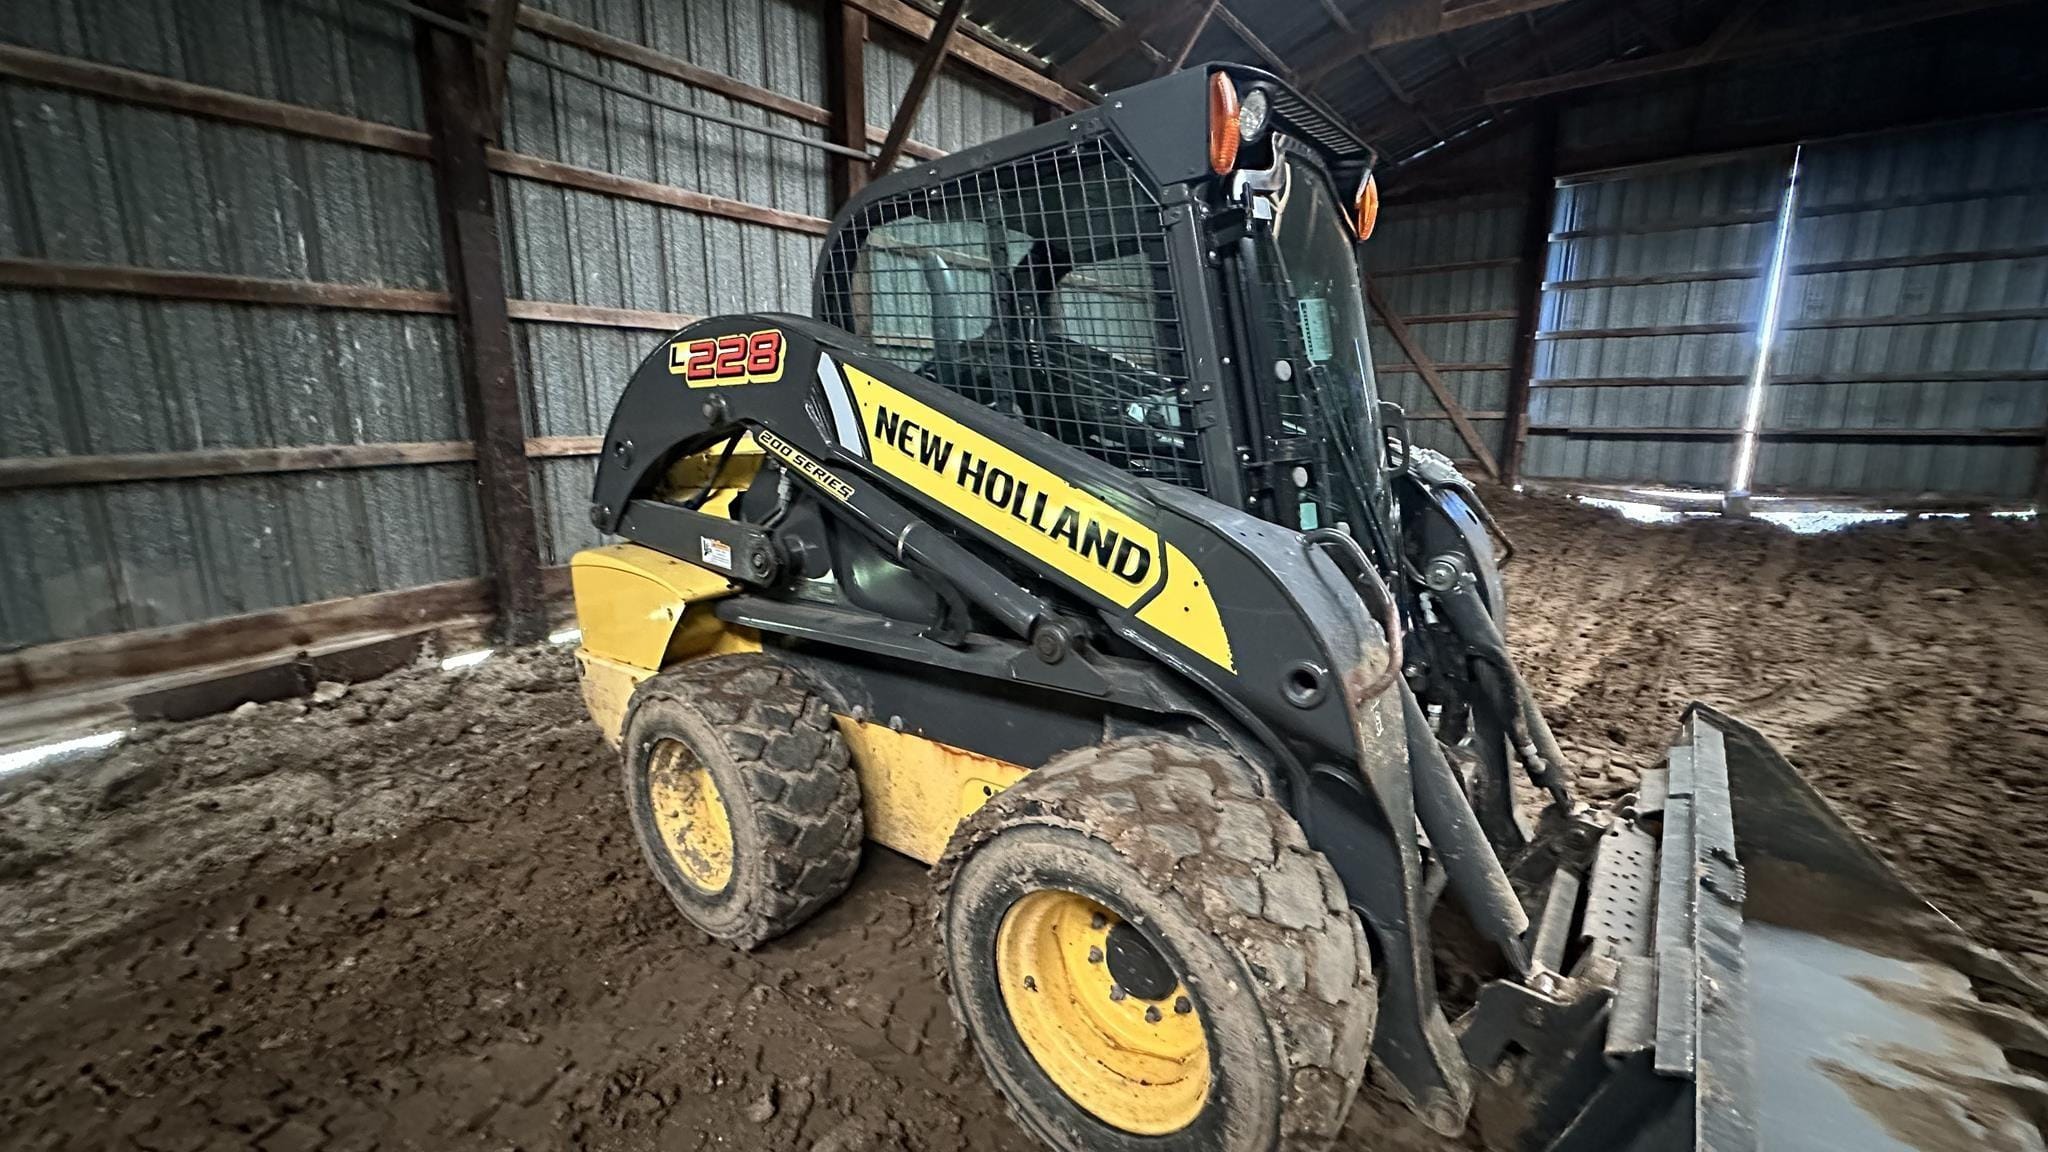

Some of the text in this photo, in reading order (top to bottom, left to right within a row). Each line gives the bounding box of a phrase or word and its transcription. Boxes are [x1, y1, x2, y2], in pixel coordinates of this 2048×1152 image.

[760, 431, 854, 498] 200 SERIES
[874, 405, 1151, 585] NEW HOLLAND
